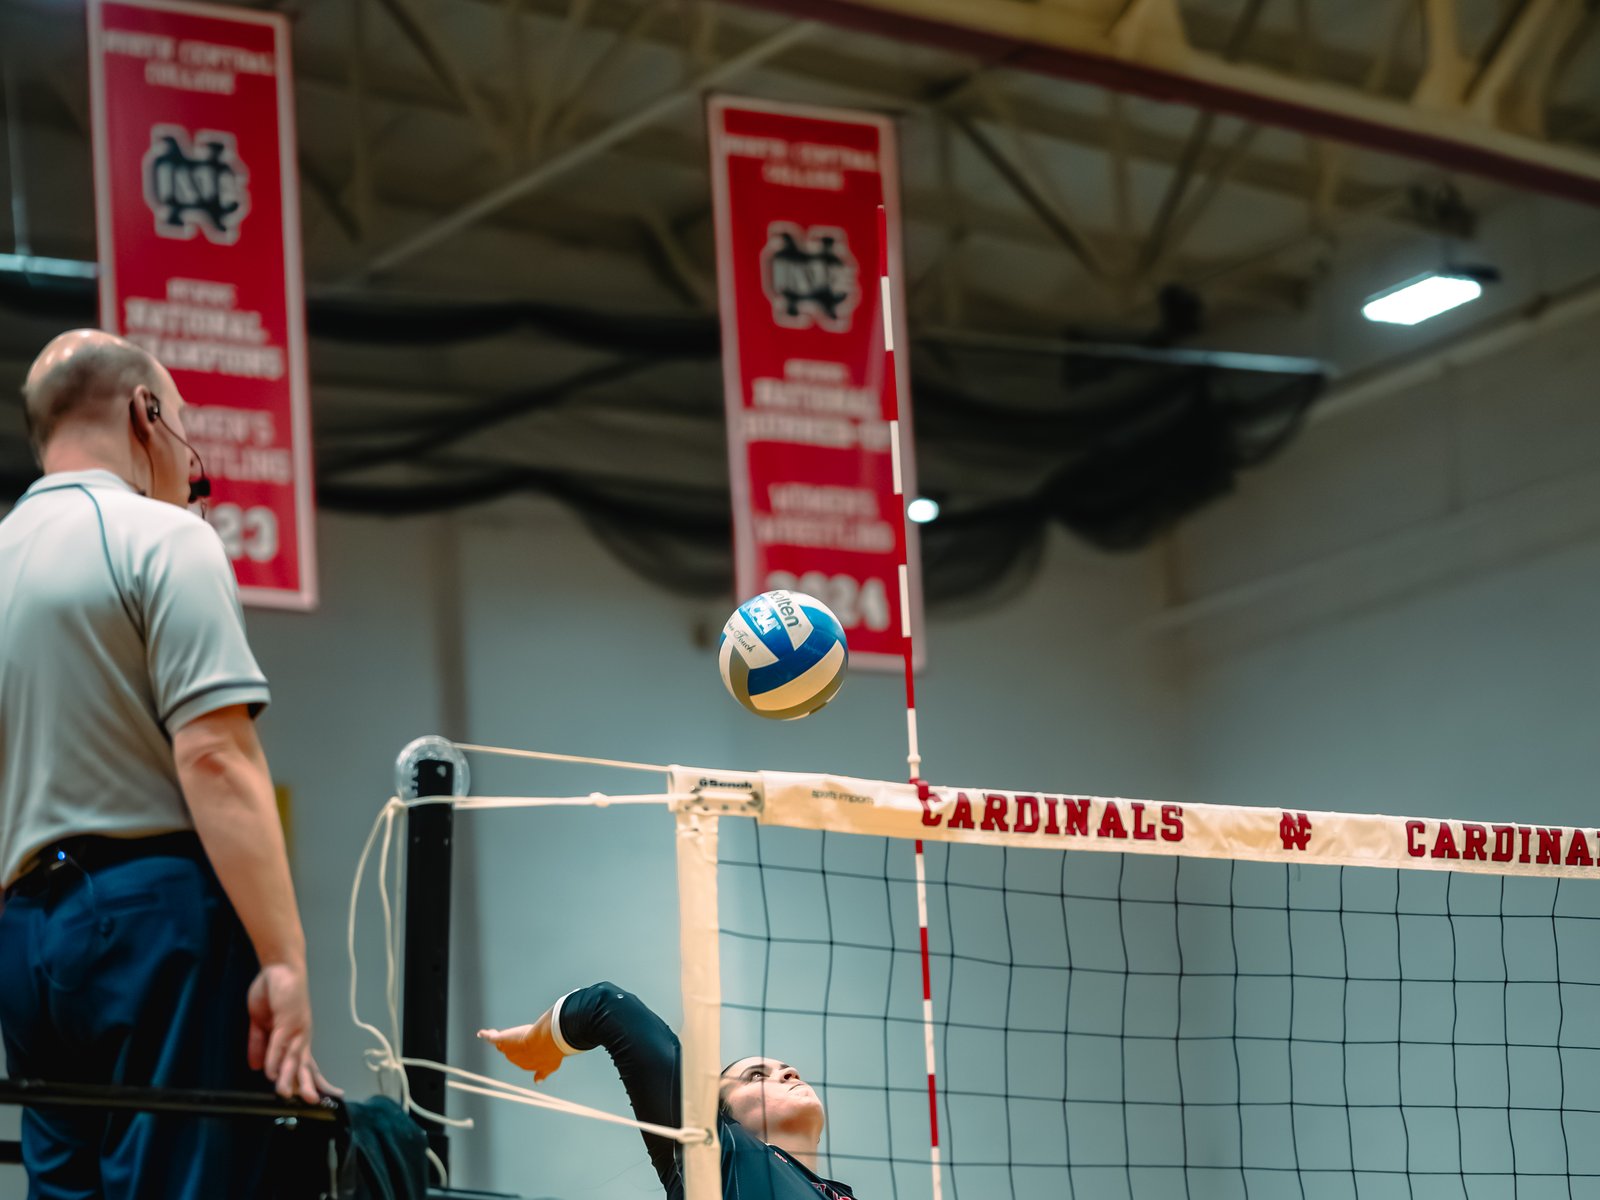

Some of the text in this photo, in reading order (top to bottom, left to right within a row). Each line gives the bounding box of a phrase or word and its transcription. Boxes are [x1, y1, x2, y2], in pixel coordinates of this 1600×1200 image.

[126, 333, 285, 382] HAMPIONS
[182, 404, 275, 446] MEN'S
[209, 502, 279, 563] 23
[770, 591, 800, 627] olten
[921, 791, 1184, 842] CARDINALS
[1405, 820, 1600, 867] CARDINA
